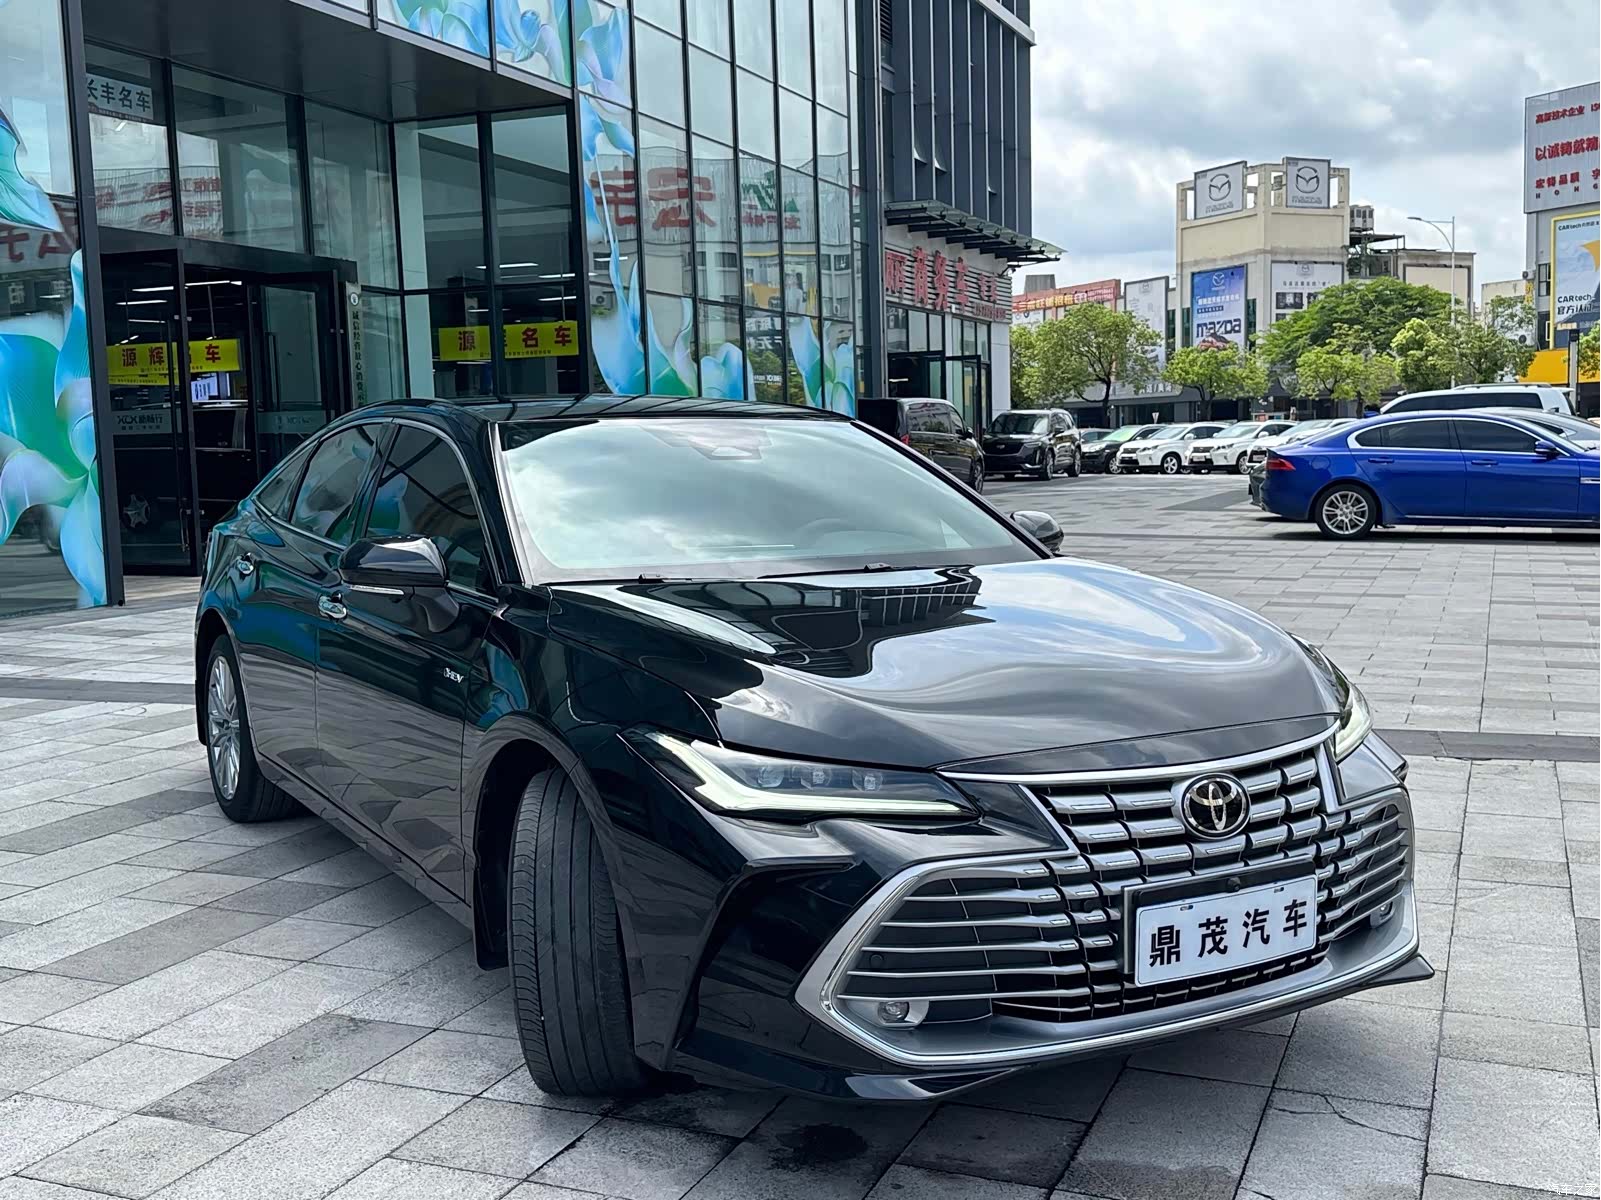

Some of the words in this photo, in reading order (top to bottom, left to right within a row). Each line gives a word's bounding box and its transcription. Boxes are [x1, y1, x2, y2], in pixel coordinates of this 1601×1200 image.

[87, 79, 151, 112] 长丰名车
[1196, 318, 1242, 338] mazda
[1148, 898, 1309, 968] 鼎茂汽车
